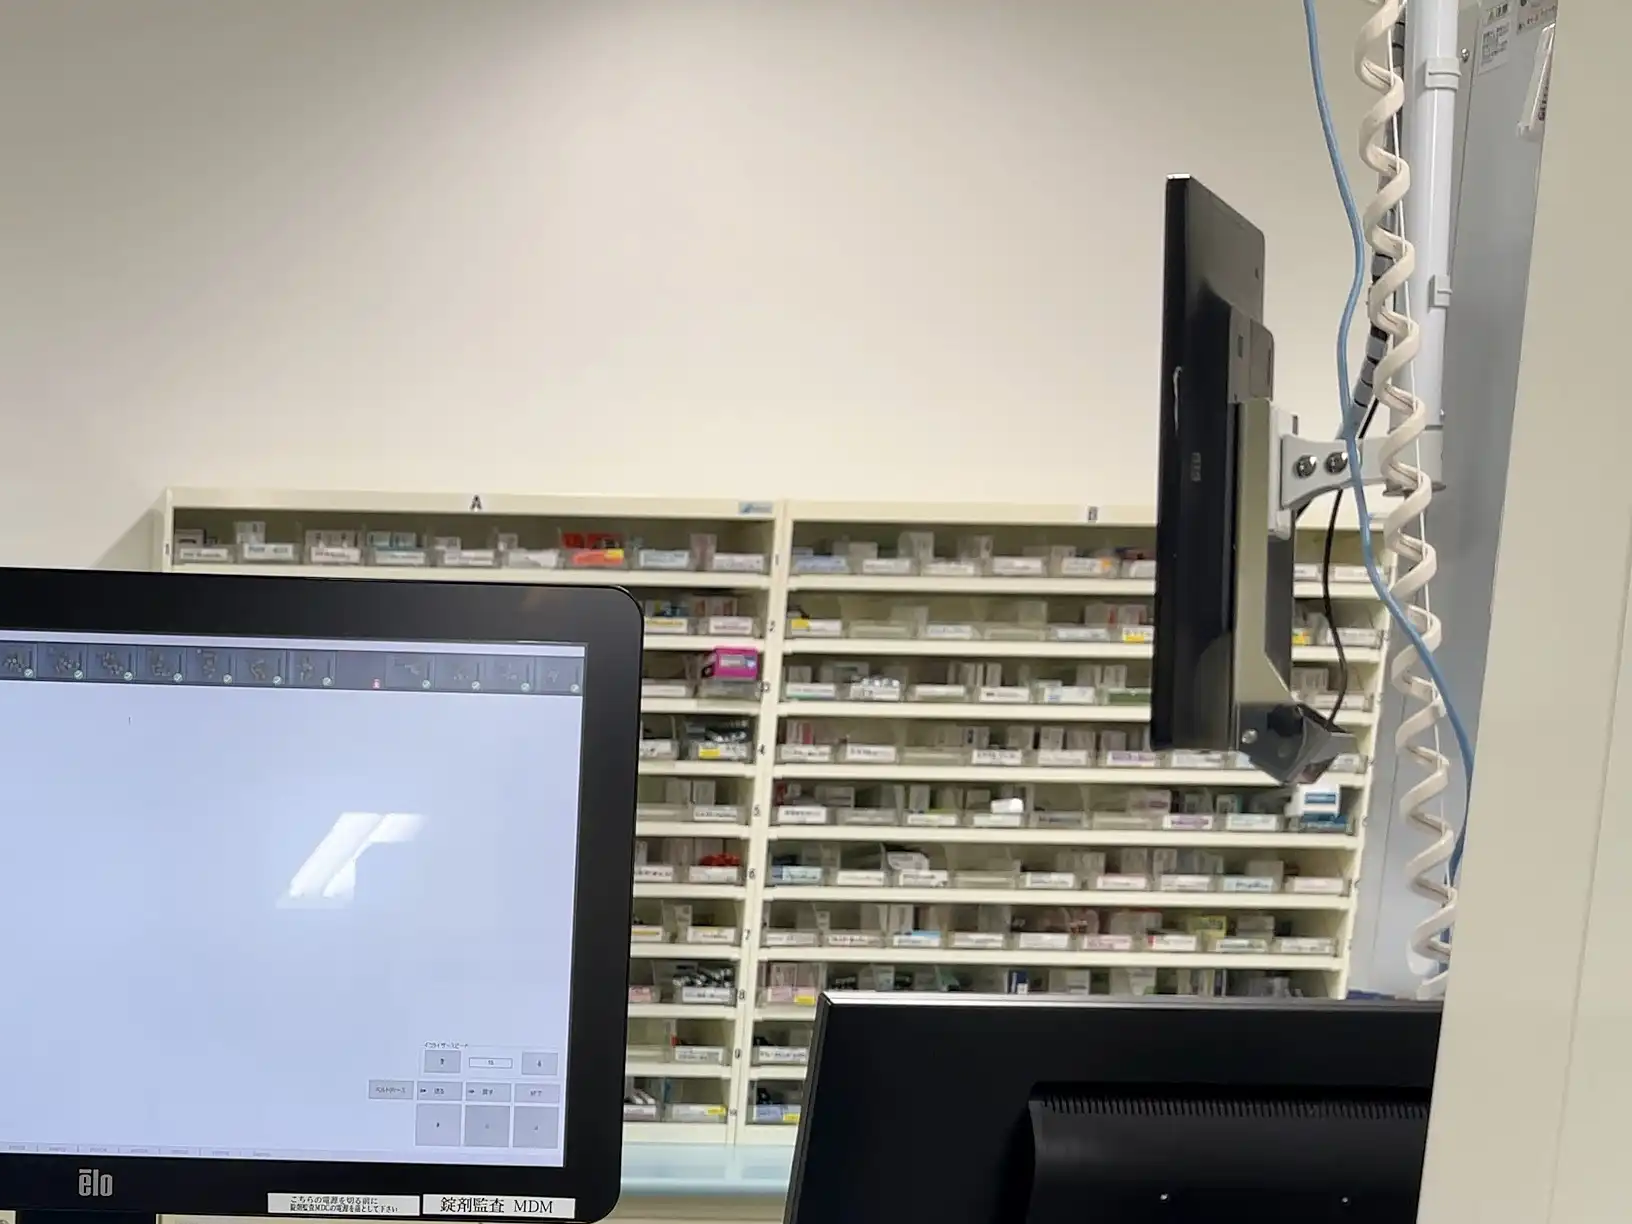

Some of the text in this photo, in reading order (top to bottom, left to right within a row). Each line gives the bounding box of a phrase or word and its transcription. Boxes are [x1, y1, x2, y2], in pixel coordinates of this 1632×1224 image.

[470, 494, 482, 510] A
[440, 1197, 553, 1213] 錠剤監査 MDM
